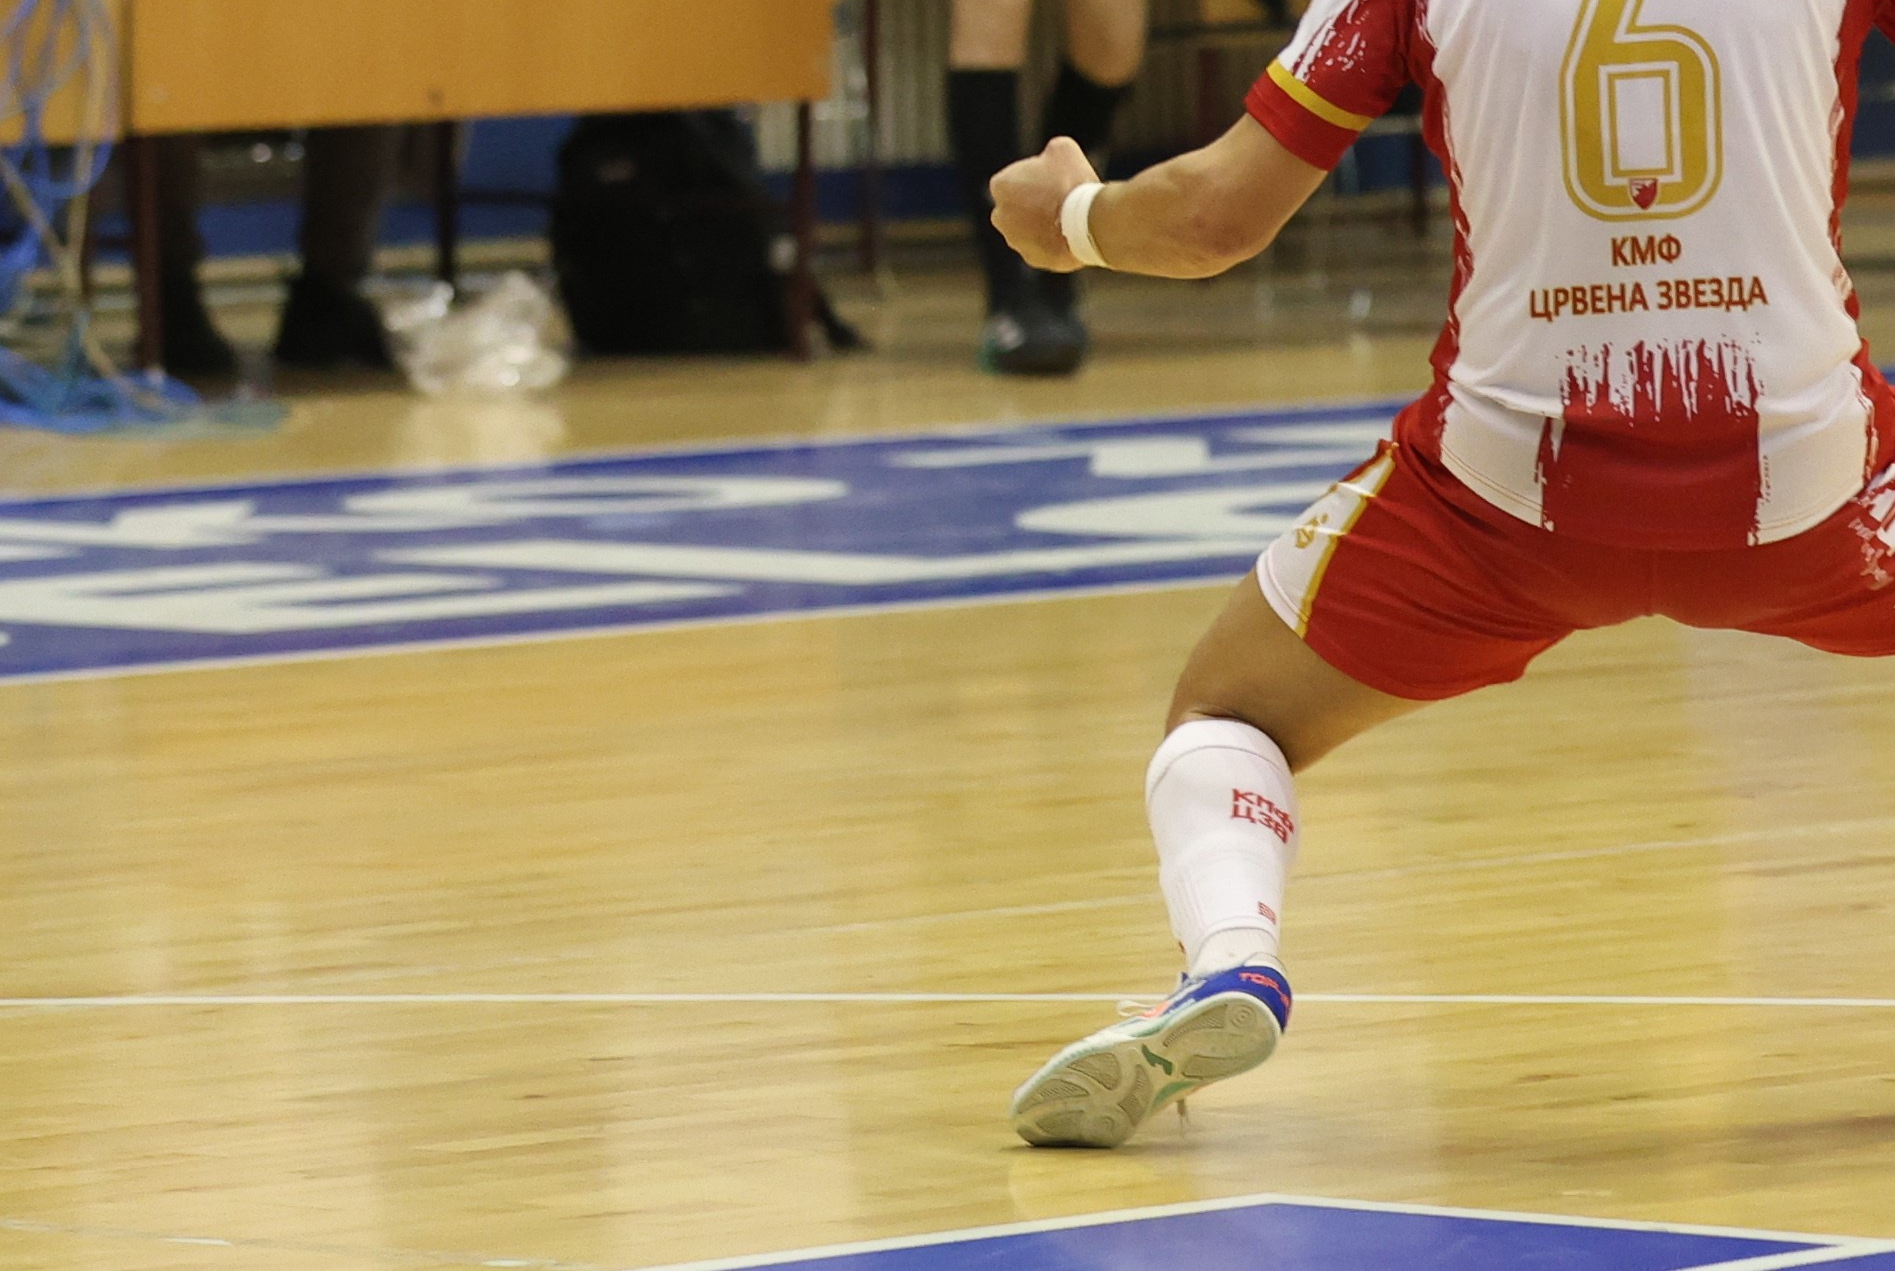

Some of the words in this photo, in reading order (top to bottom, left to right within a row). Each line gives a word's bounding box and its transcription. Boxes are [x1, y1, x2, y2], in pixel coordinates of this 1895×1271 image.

[1610, 232, 1682, 267] КМФ
[1529, 281, 1650, 323] ЦРВЕНА
[1656, 275, 1769, 313] ЗВЕЗДА
